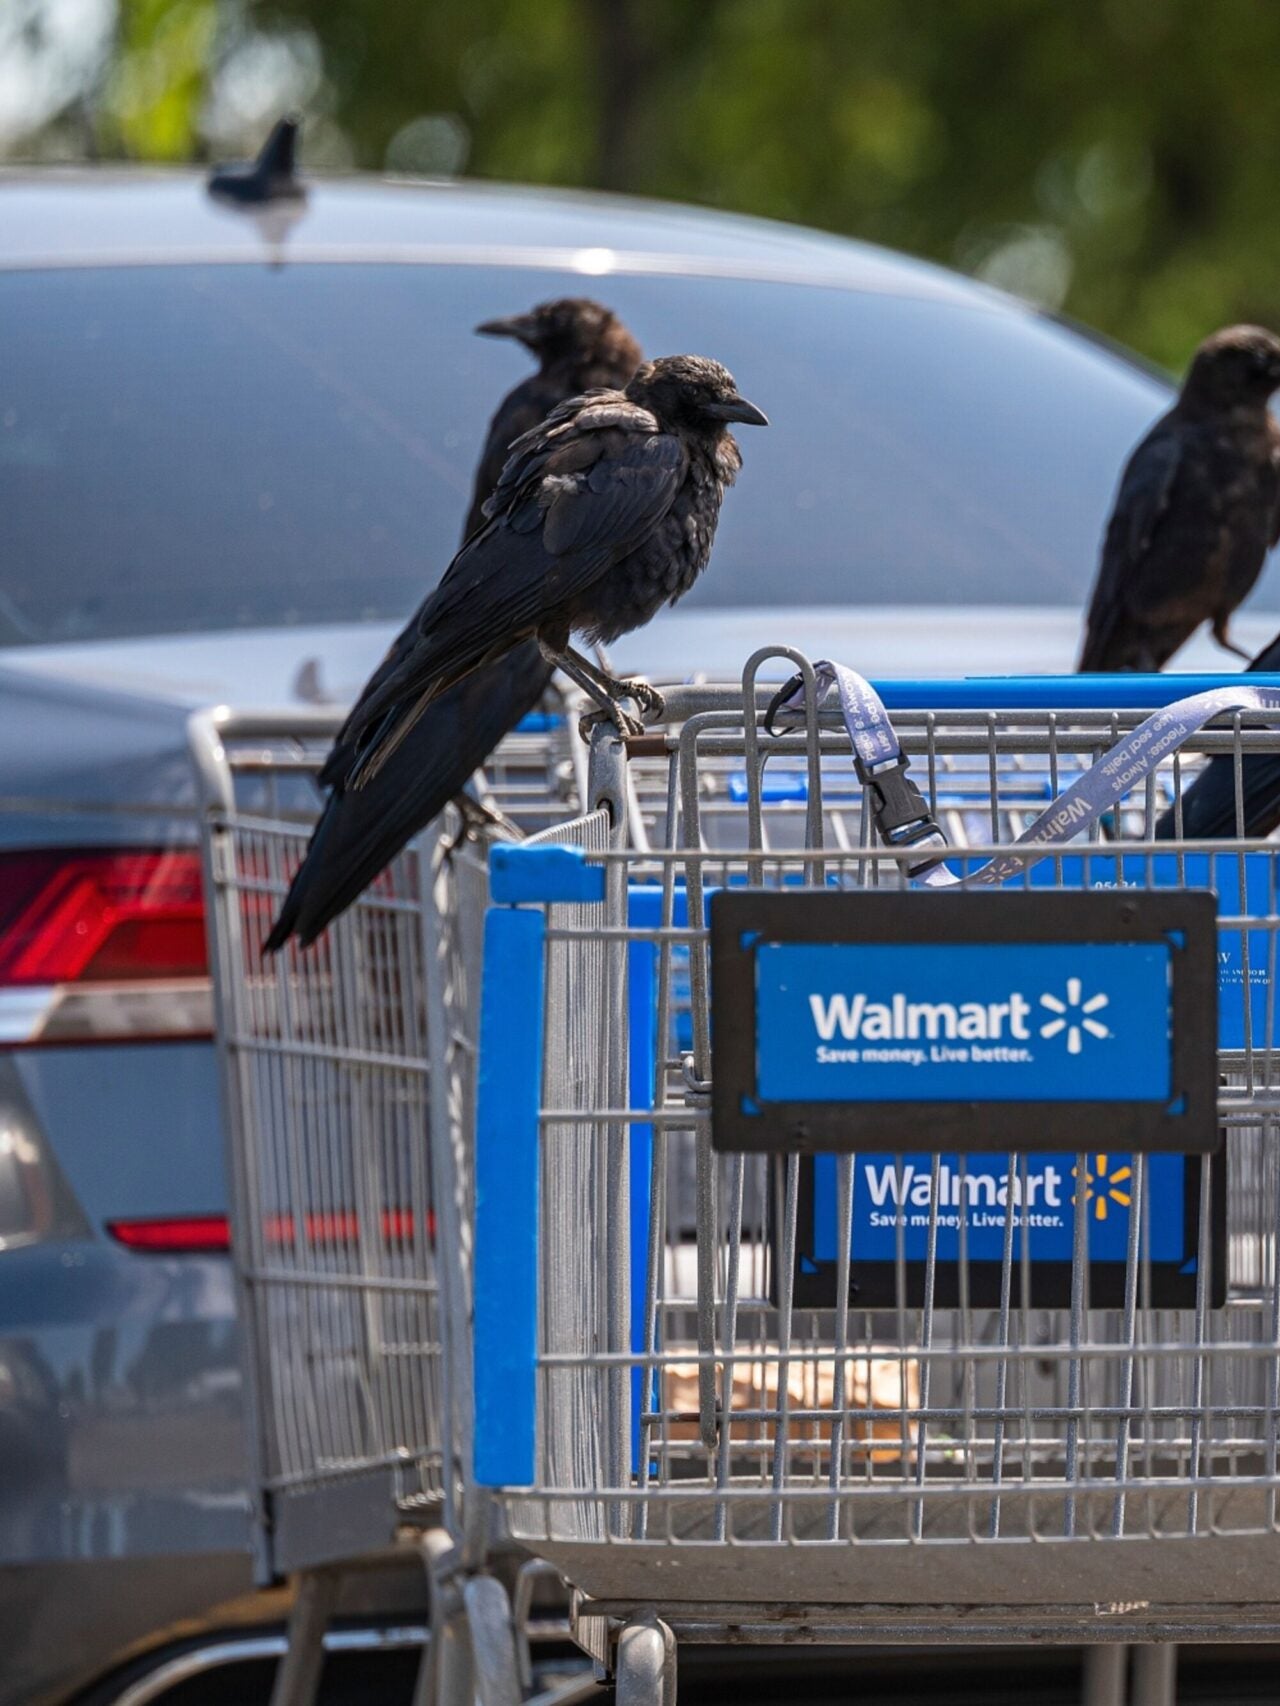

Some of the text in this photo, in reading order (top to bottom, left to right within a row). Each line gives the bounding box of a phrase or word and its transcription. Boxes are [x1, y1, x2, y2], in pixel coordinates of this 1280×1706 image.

[1153, 712, 1174, 732] use
[1112, 722, 1188, 792] Please: Always
[1128, 730, 1153, 755] seat
[1011, 797, 1093, 867] Walmt
[809, 993, 1031, 1041] Walmart
[816, 1045, 1033, 1066] Save money. Live better.
[864, 1165, 1062, 1207] Walmart
[870, 1212, 908, 1227] Save
[972, 1212, 1006, 1227] Live
